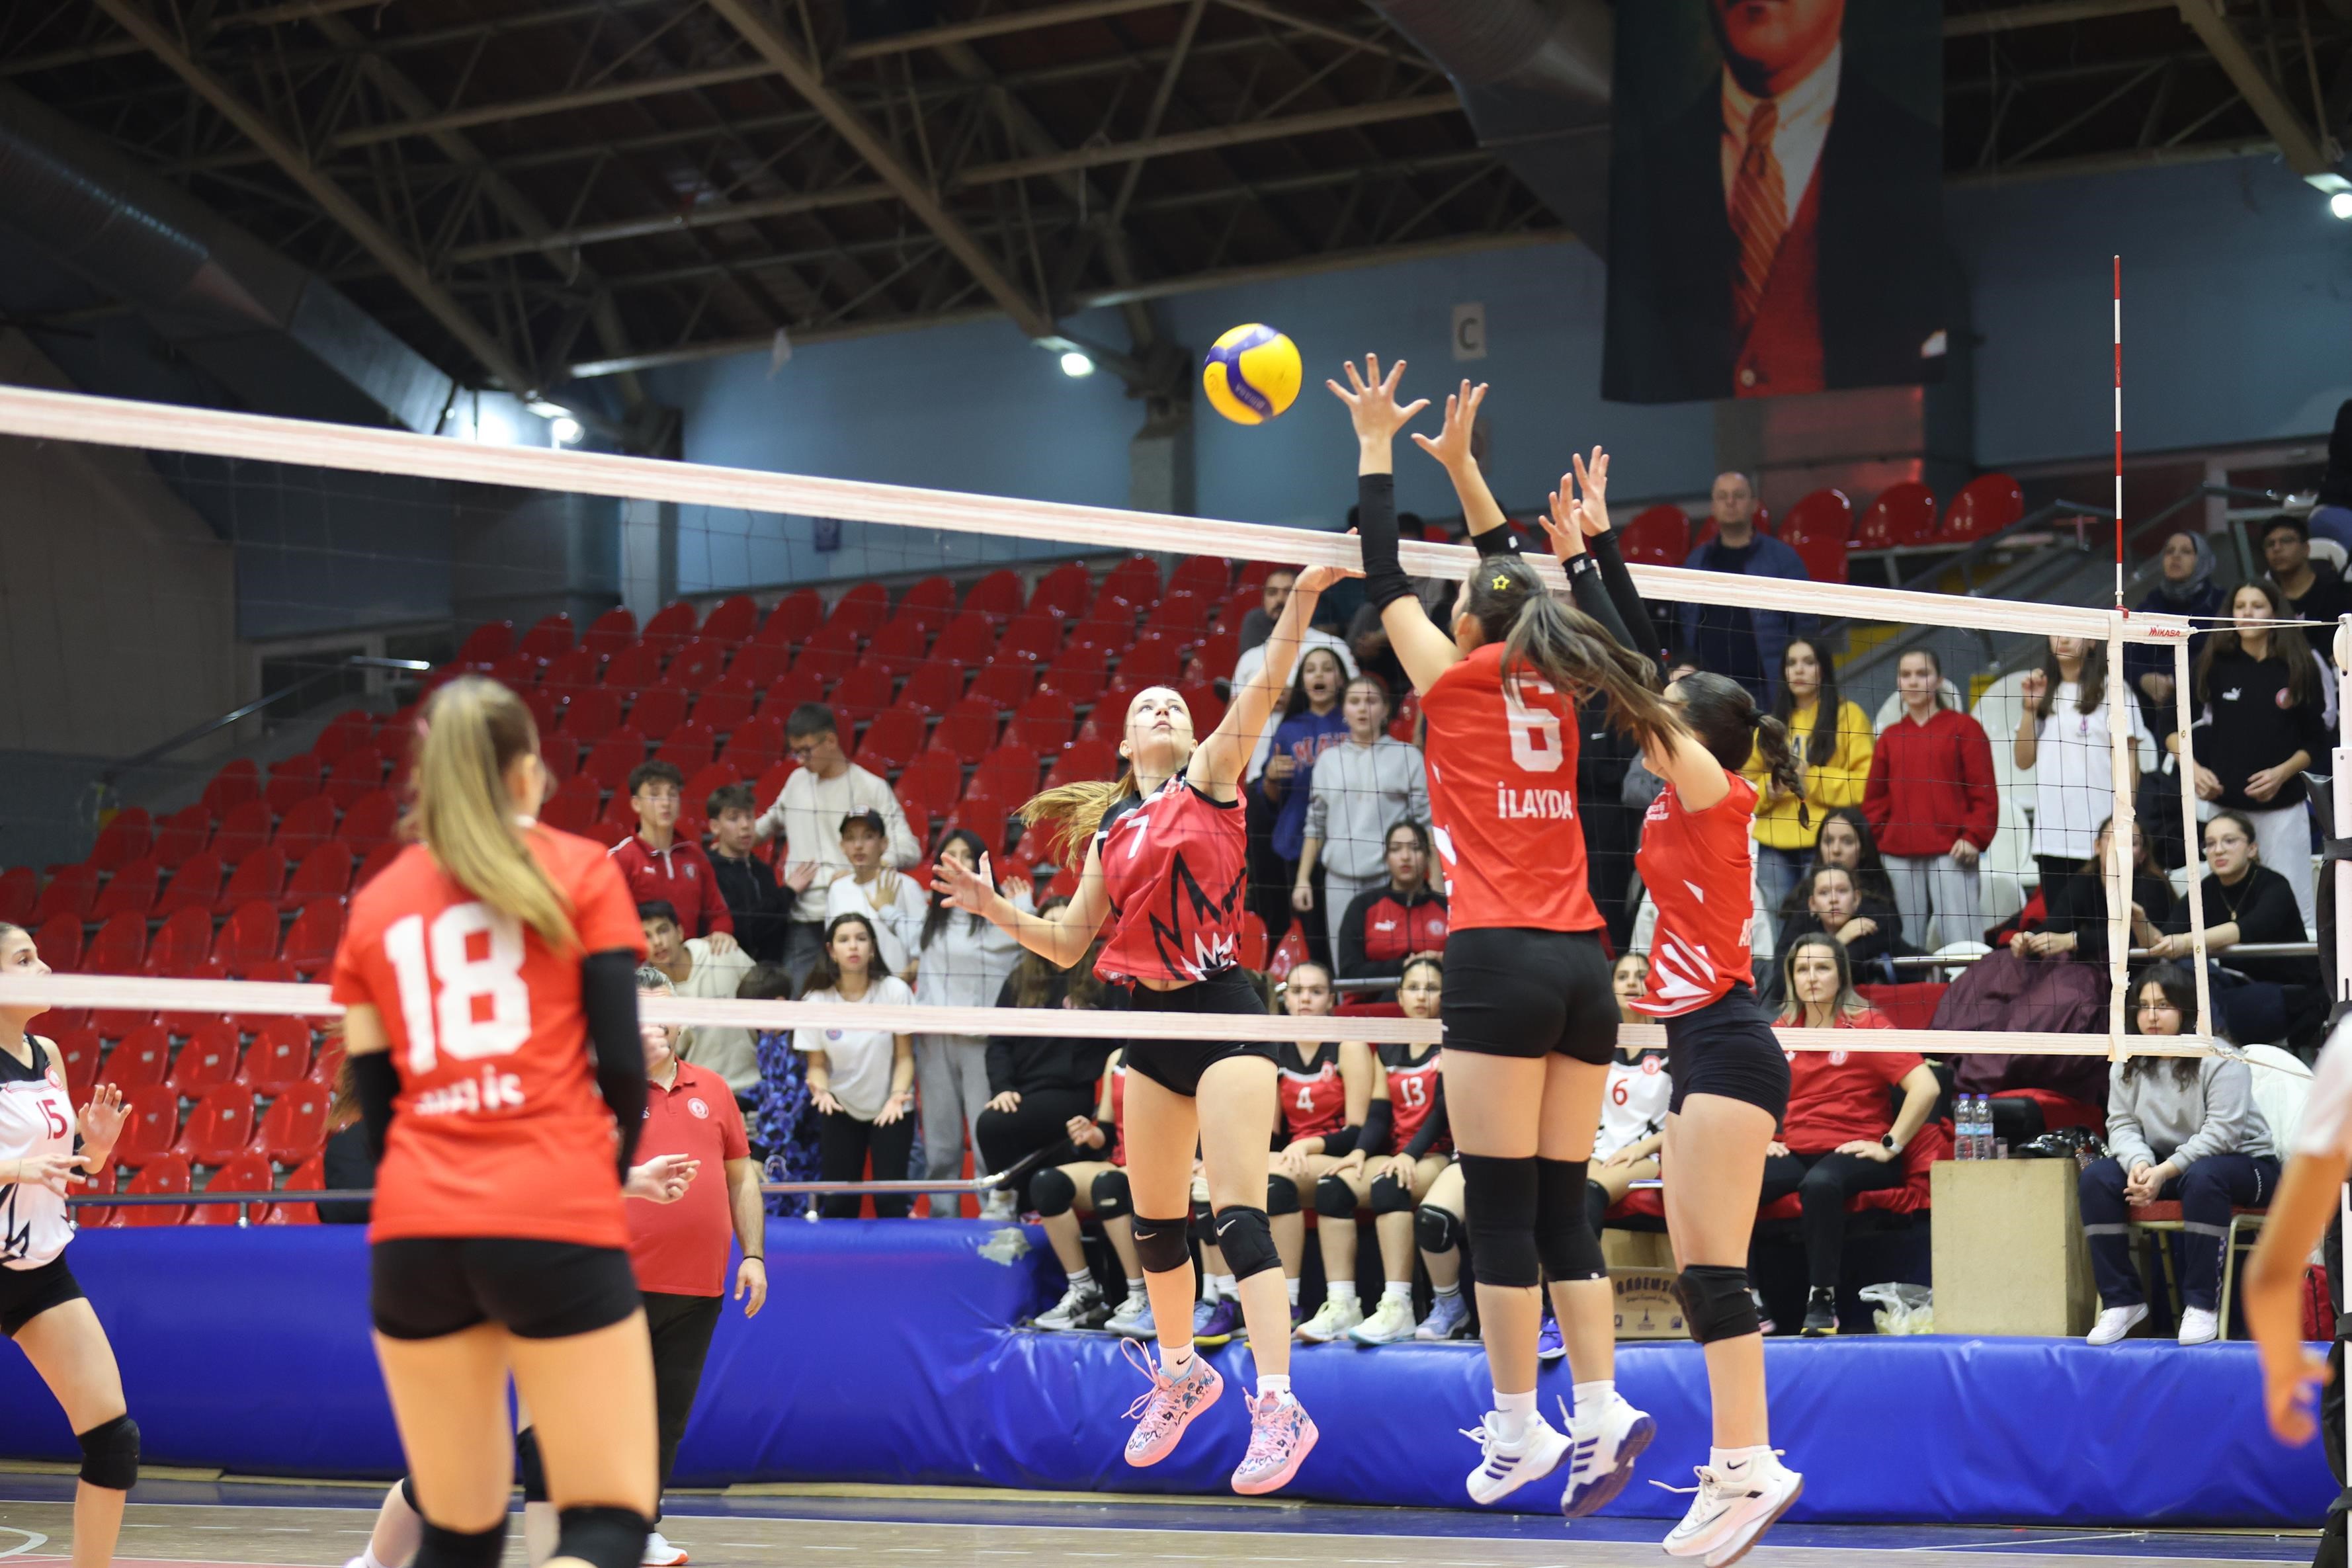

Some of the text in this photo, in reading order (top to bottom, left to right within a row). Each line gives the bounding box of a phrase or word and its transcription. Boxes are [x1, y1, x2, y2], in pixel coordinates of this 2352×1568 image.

[1457, 317, 1479, 351] C
[1501, 671, 1564, 772] 6
[1497, 781, 1574, 819] İLAYDA
[1126, 814, 1150, 860] 7
[383, 901, 532, 1075] 18
[1296, 1087, 1315, 1113] 4
[1400, 1076, 1426, 1107] 13
[1613, 1078, 1628, 1106] 6
[36, 1098, 68, 1140] 15
